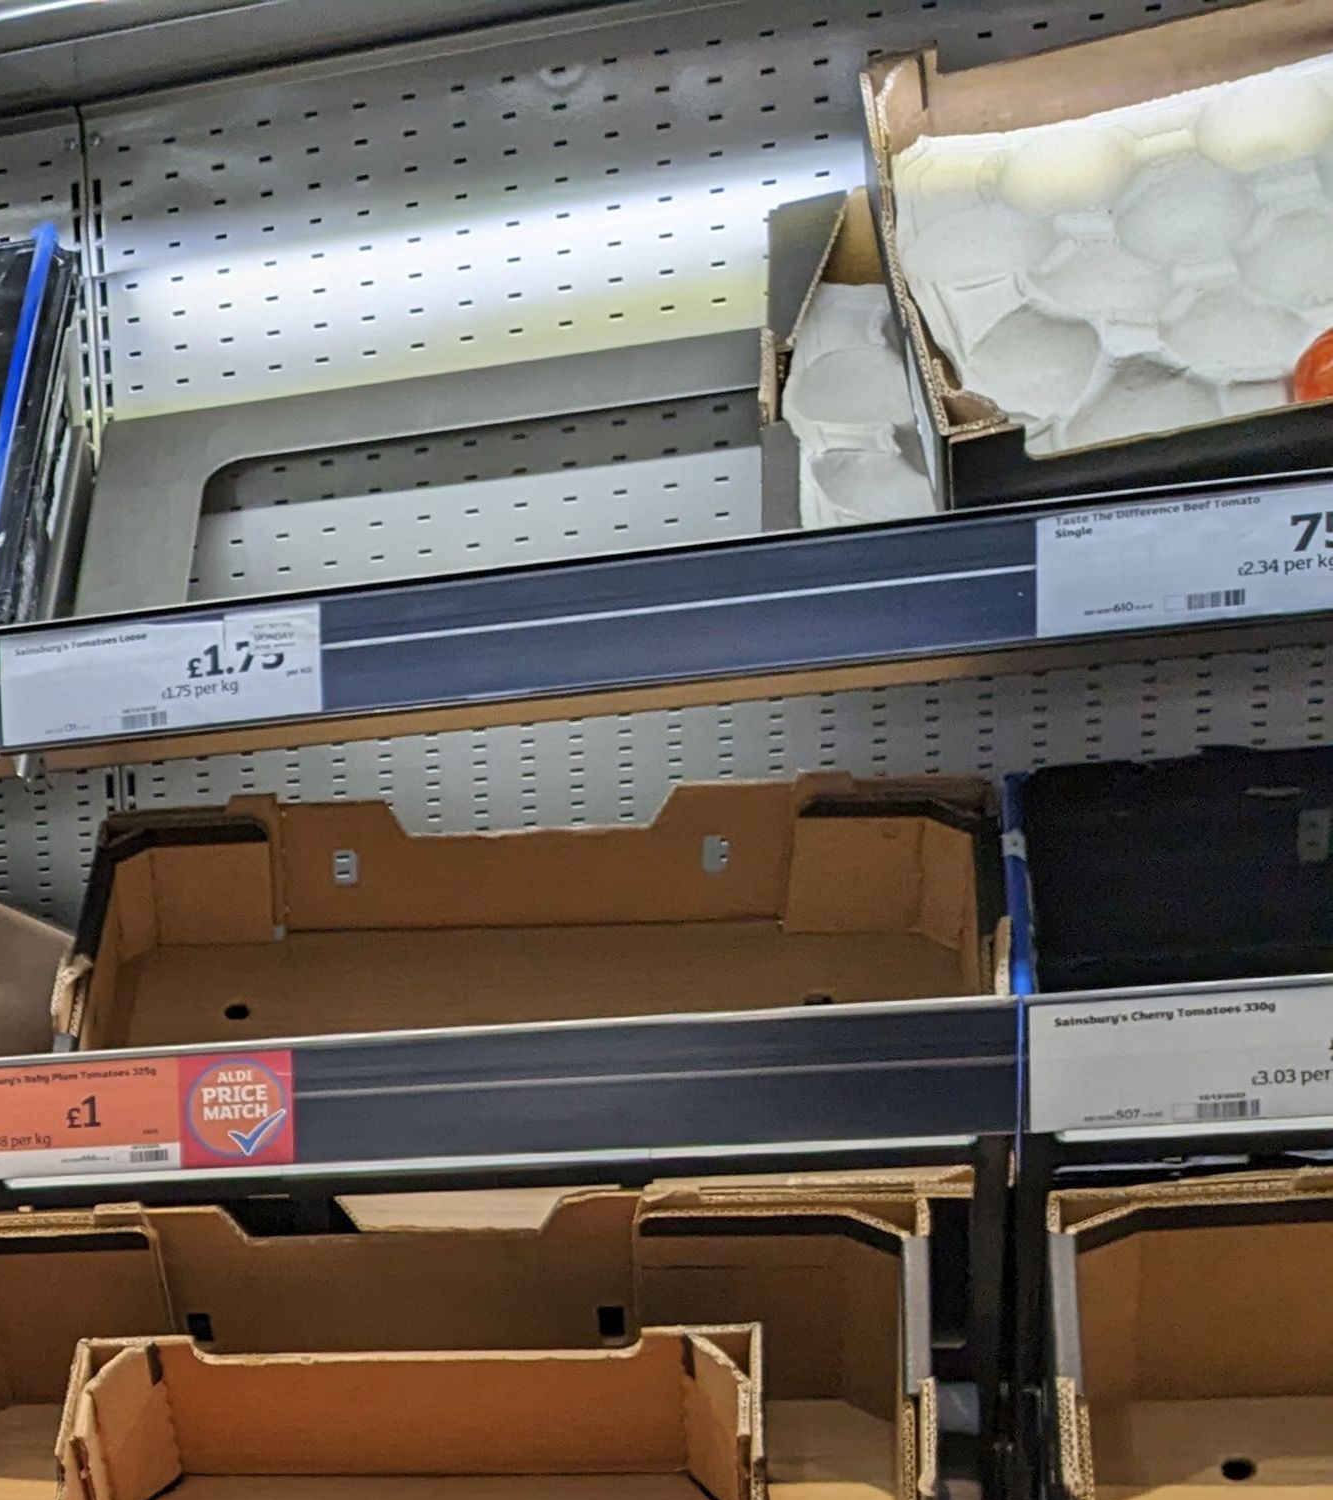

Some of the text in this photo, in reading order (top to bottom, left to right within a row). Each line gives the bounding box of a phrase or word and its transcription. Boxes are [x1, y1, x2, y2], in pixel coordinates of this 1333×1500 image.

[1056, 516, 1089, 526] Taste
[1116, 504, 1179, 520] Difference
[1183, 500, 1210, 512] Beef
[1214, 496, 1261, 508] Tomato
[1055, 526, 1093, 539] Single
[1238, 557, 1312, 576] £2.34 per
[14, 632, 147, 657] Sainsbury's Tomatoes Loose
[194, 683, 217, 698] per
[221, 679, 238, 695] kg
[1054, 1001, 1276, 1027] Sainsbury's Cherry Tomatoes 330g
[52, 1072, 79, 1082] Plum
[81, 1069, 130, 1080] Tomatoes
[217, 1071, 252, 1082] ALDI
[202, 1084, 268, 1103] PRICE
[66, 1095, 101, 1129] £1
[203, 1104, 267, 1121] MATCH
[11, 1132, 52, 1149] per kg
